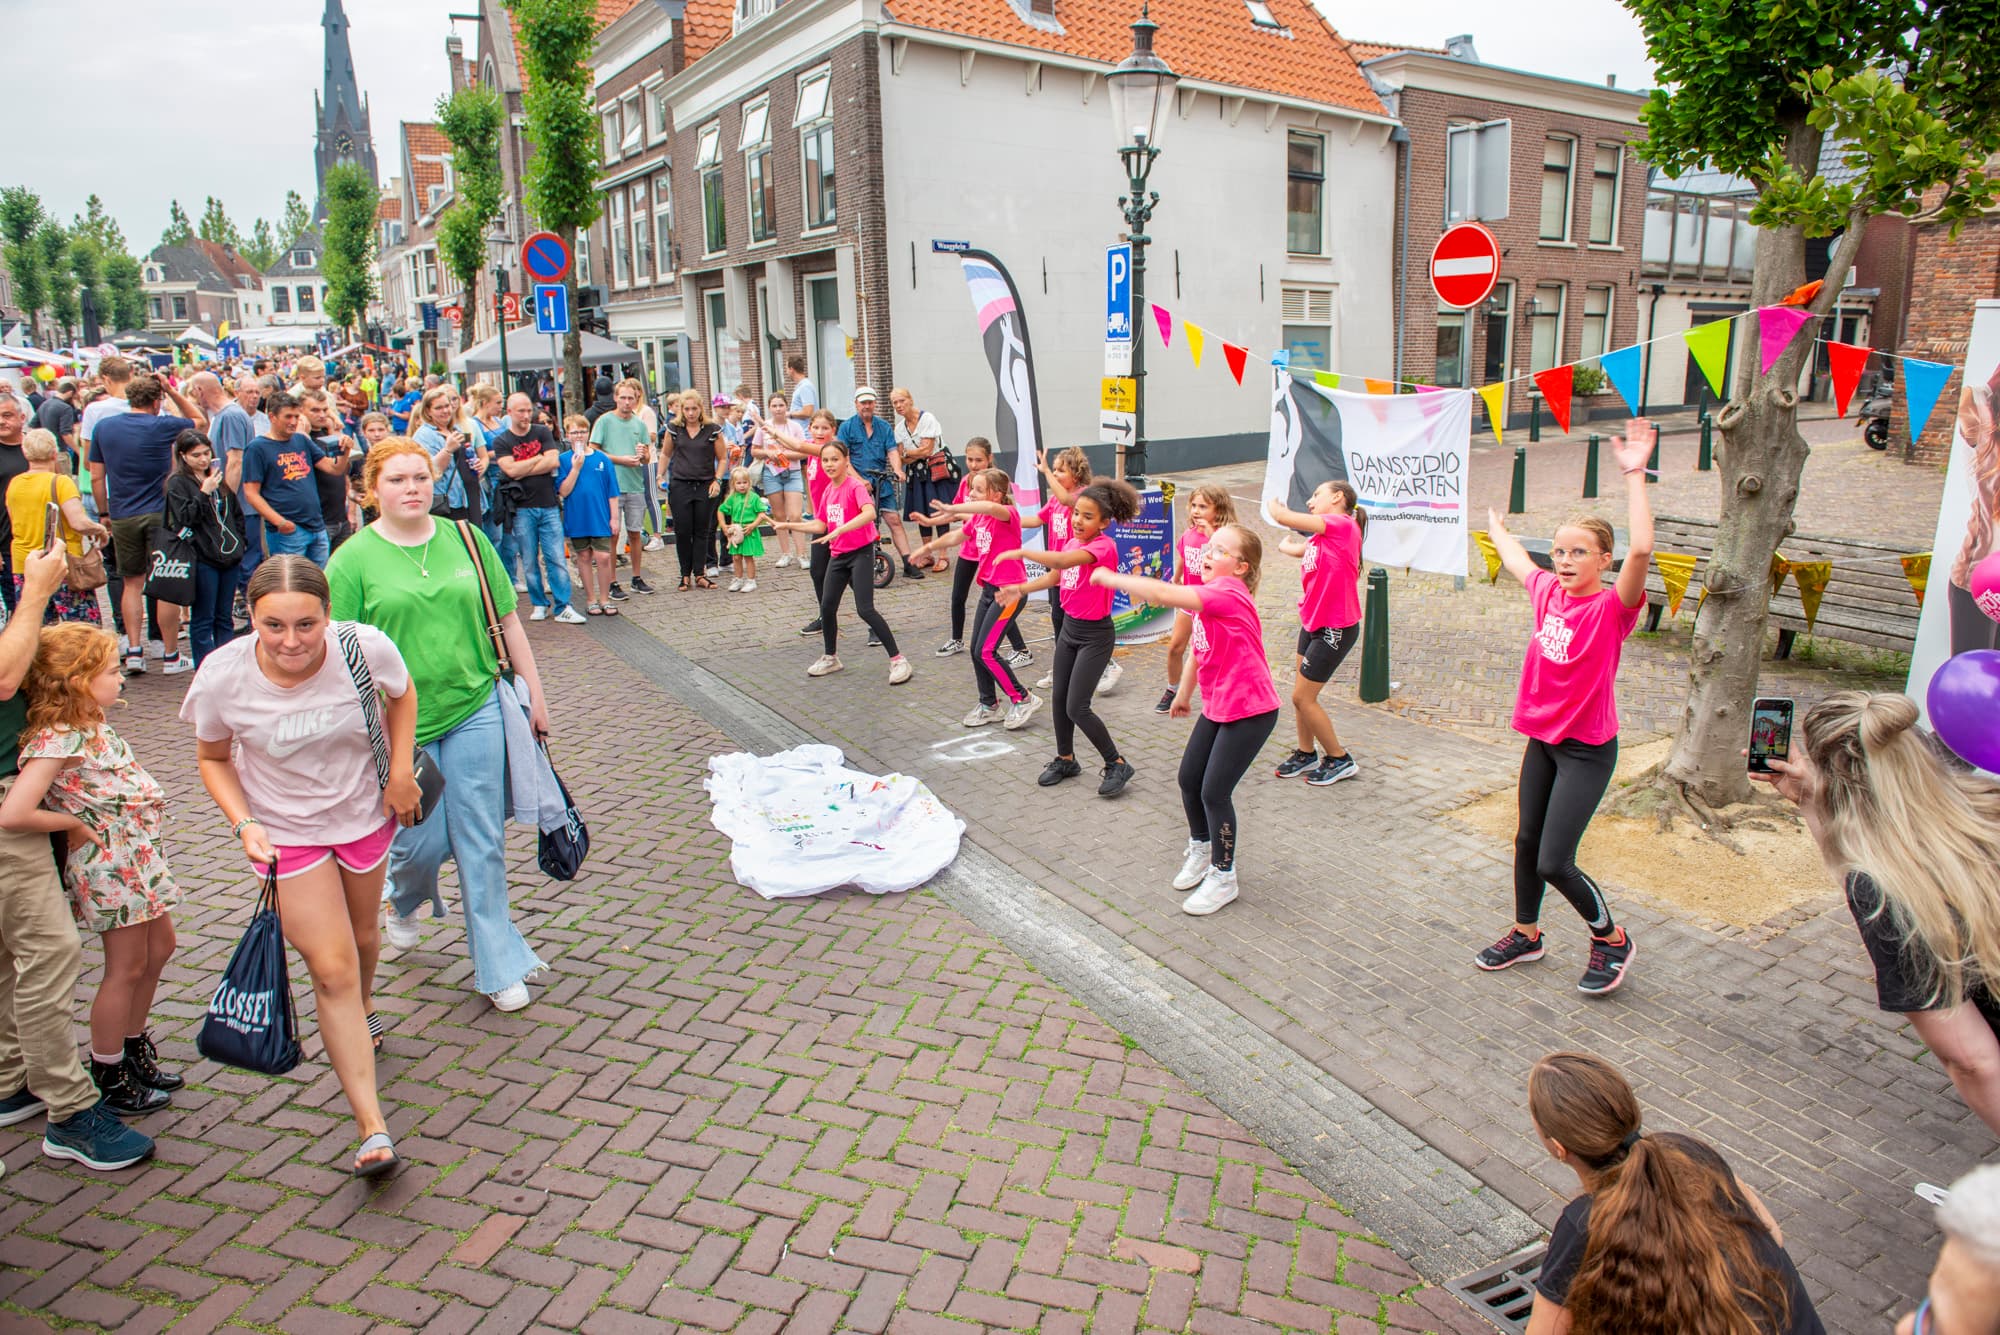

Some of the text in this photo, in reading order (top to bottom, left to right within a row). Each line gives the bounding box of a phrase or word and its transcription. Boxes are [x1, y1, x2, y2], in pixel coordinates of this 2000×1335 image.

[1111, 253, 1126, 301] P
[1353, 473, 1391, 496] VAN
[149, 549, 191, 581] Patta
[277, 705, 334, 742] NIKE
